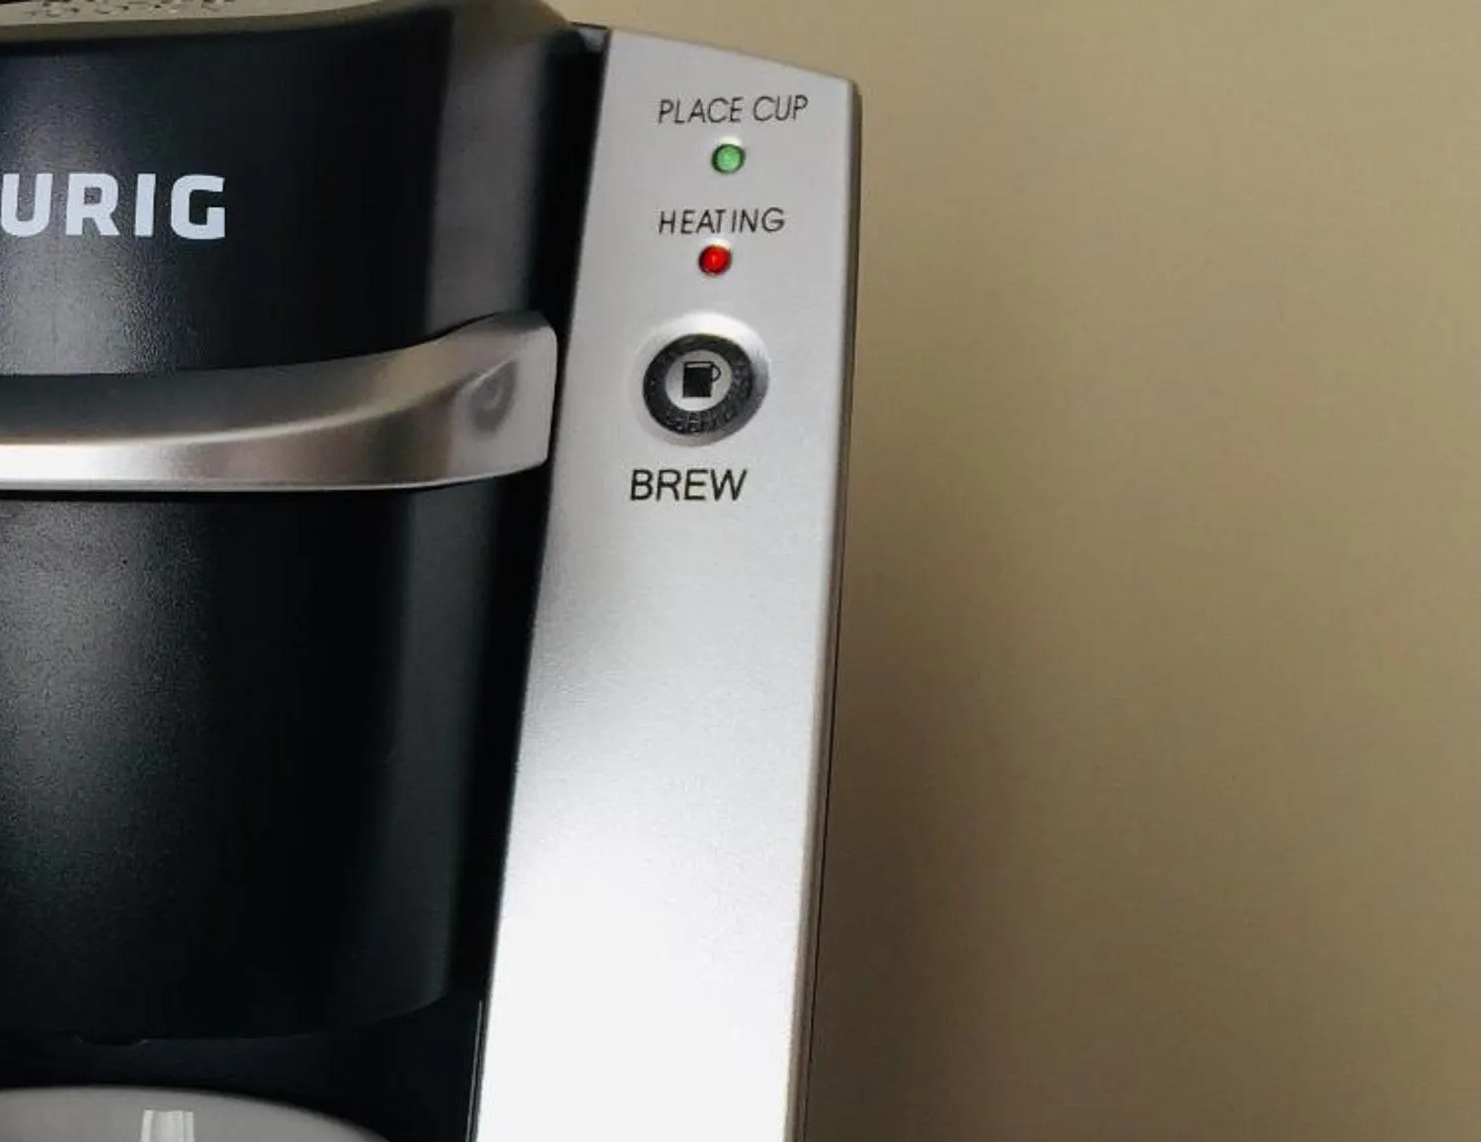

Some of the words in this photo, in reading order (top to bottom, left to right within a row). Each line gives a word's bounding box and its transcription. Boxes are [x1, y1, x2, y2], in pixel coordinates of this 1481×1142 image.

[657, 96, 744, 125] PLACE
[752, 94, 809, 122] CUP
[658, 207, 786, 235] HEATING
[629, 469, 748, 502] BREW
